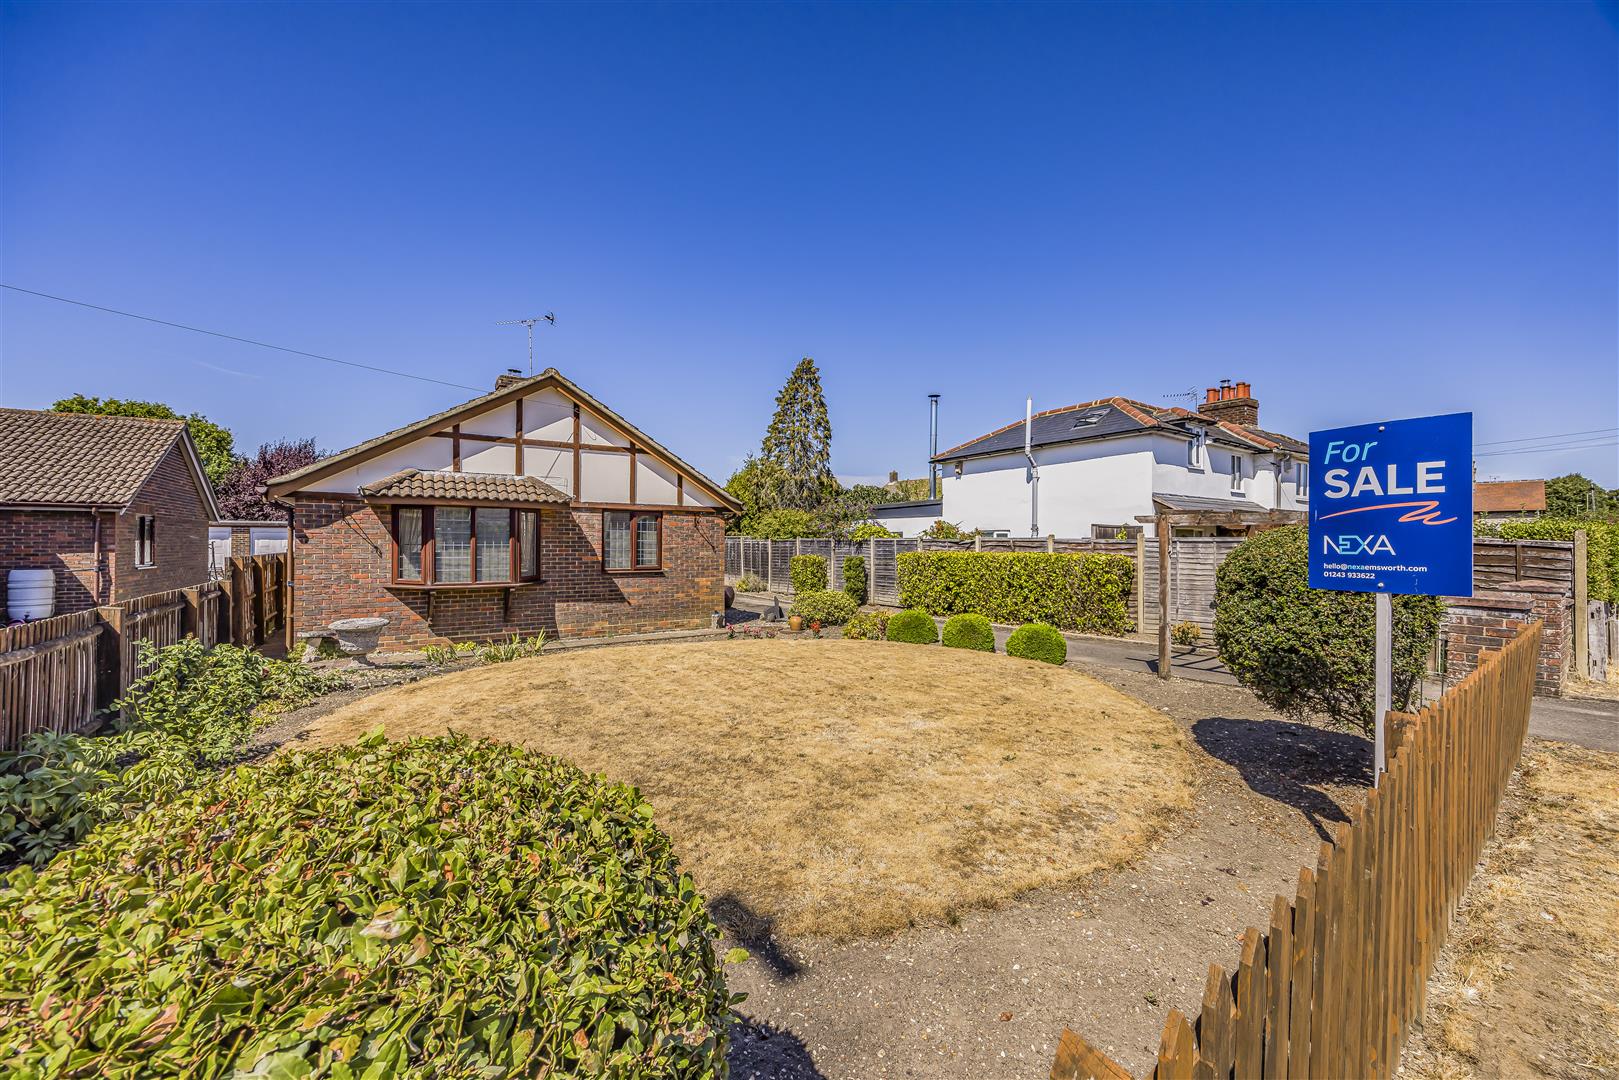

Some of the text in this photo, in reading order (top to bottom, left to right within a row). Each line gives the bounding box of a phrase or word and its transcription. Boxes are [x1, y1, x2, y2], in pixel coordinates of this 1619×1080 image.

[1324, 440, 1378, 465] For
[1324, 460, 1446, 499] SALE
[1323, 534, 1396, 556] NEXA
[1323, 563, 1427, 572] hello@nexaemsworth.com
[1323, 571, 1376, 580] 01243 933622
